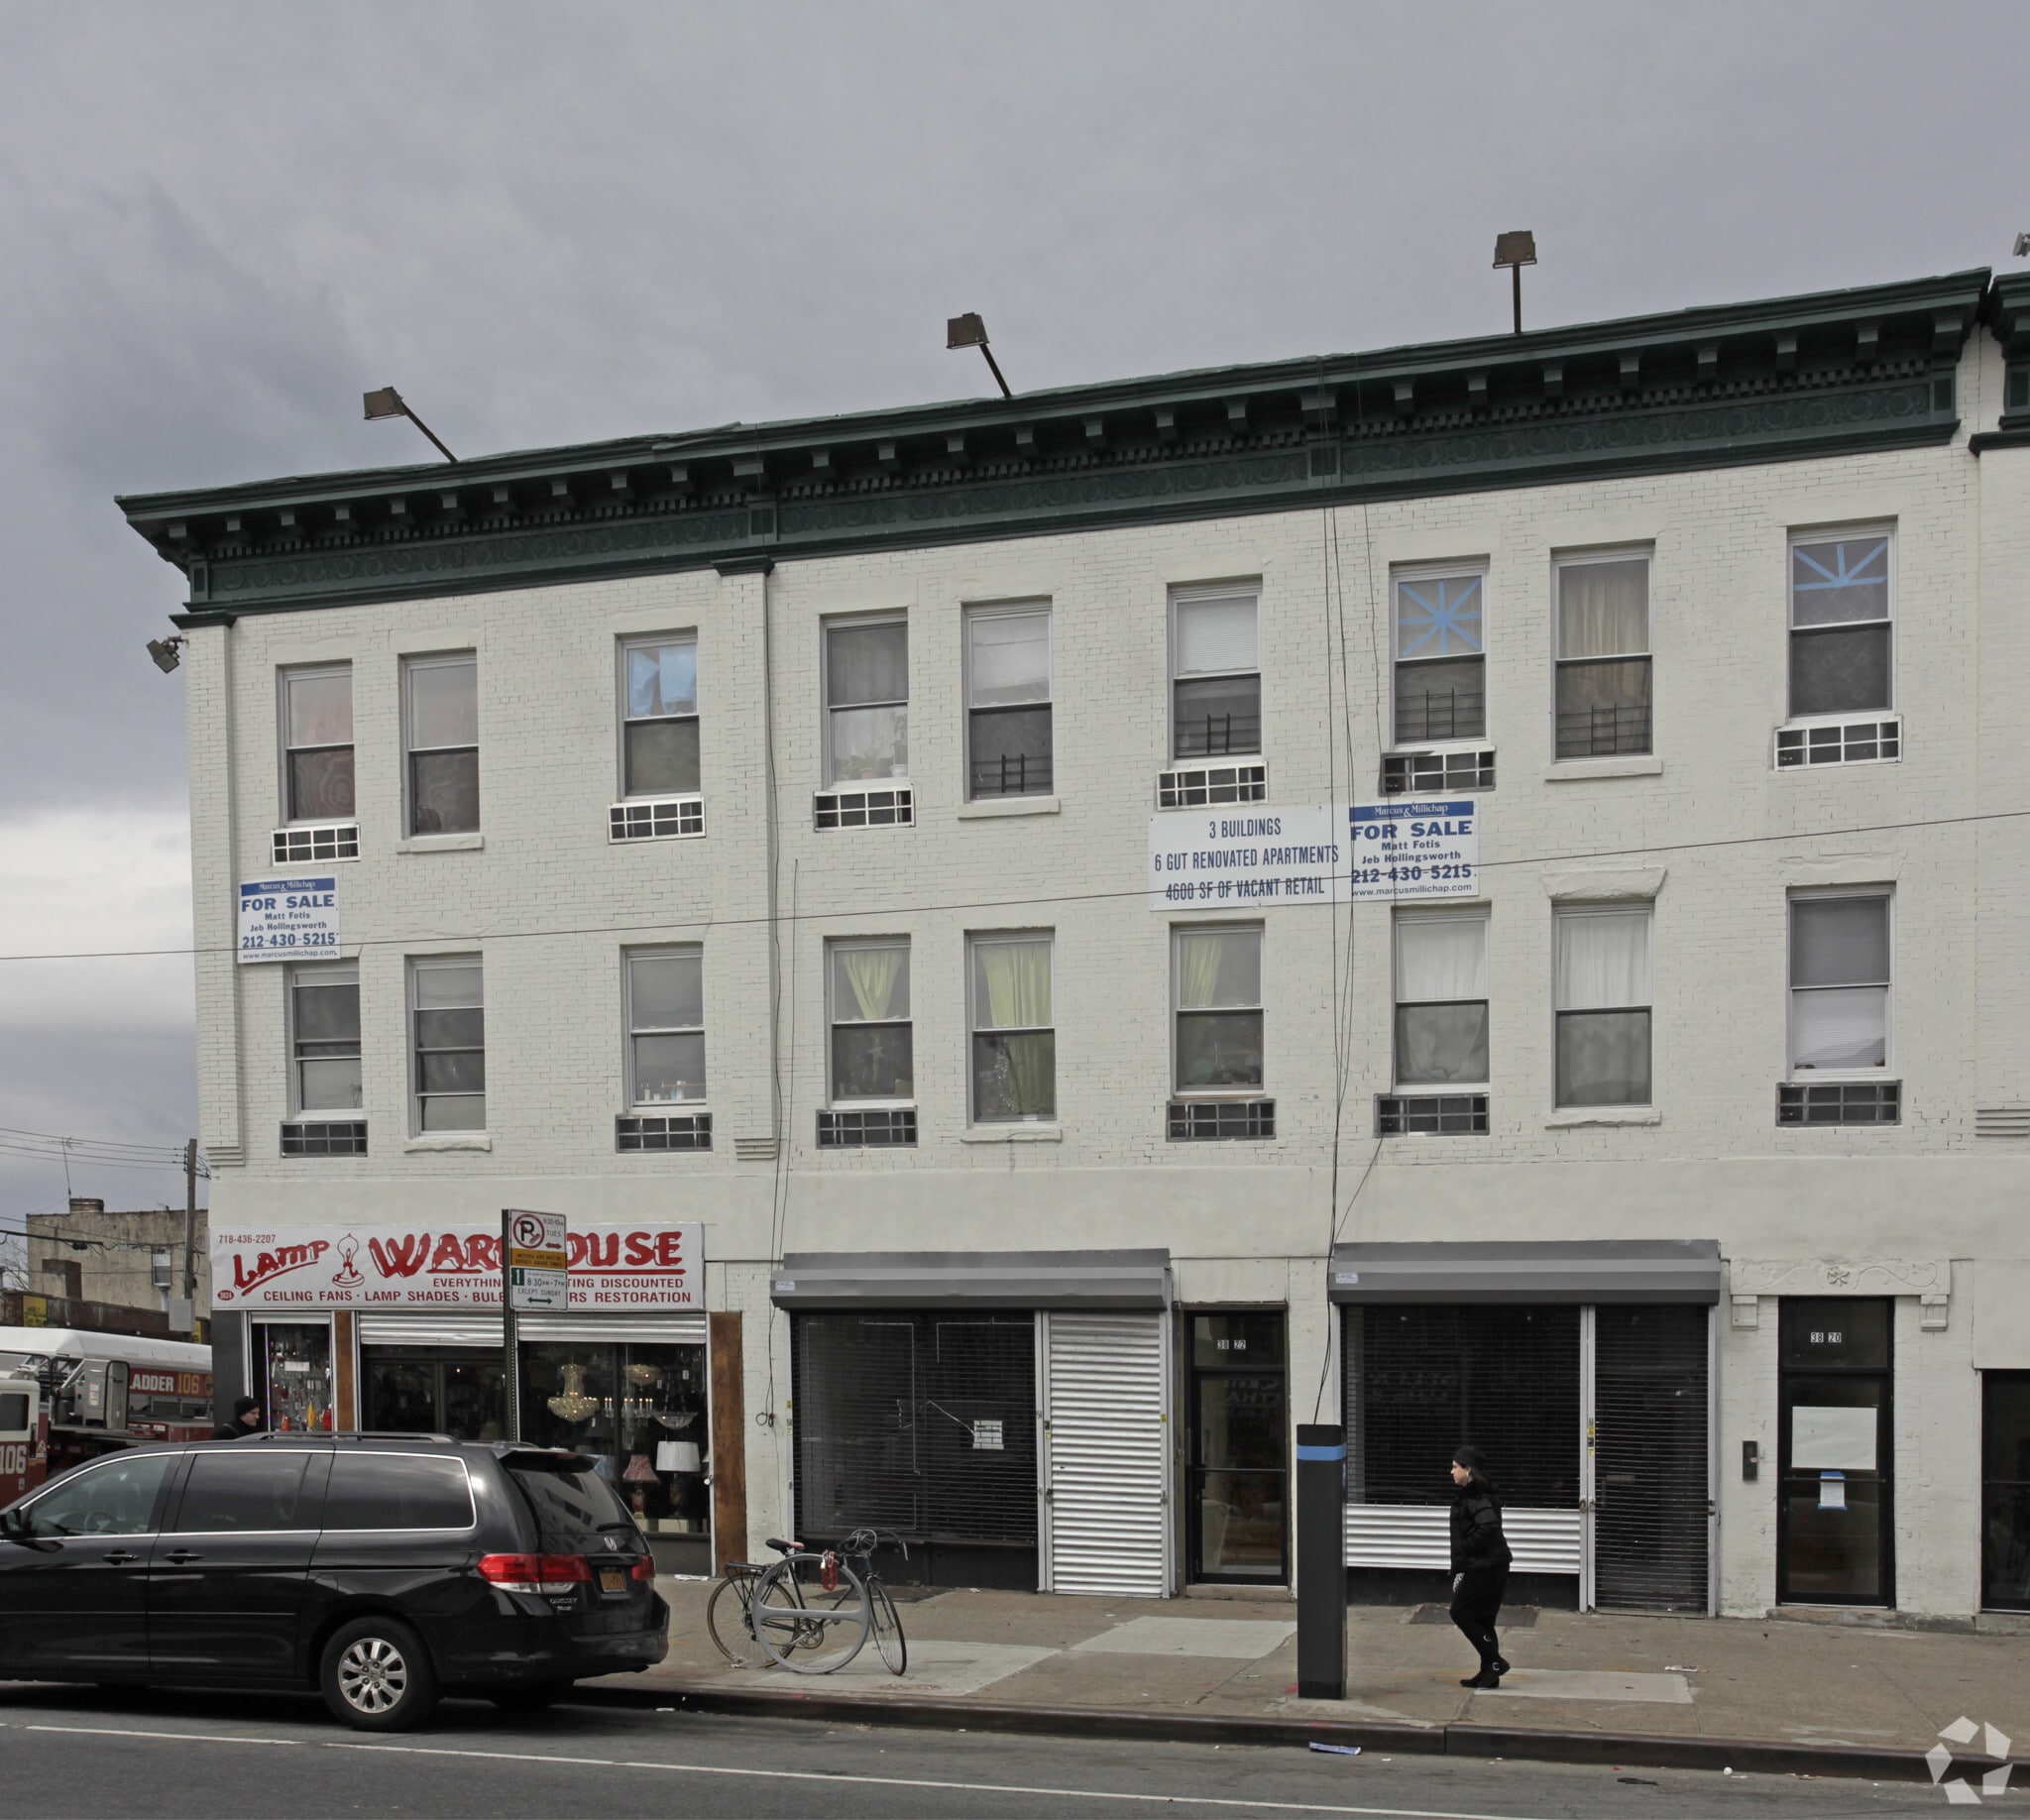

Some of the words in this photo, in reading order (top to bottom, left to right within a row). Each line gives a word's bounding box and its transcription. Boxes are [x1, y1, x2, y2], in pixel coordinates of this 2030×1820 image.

[1374, 807, 1403, 816] Marcus
[1403, 808, 1411, 818] &
[1411, 804, 1448, 815] Millichap
[1209, 821, 1216, 839] 3
[1221, 818, 1281, 838] BUILDINGS
[1350, 824, 1398, 841] FOR
[1410, 820, 1472, 837] SALE
[1381, 842, 1409, 851] Matt
[1412, 840, 1440, 850] Fotis
[1155, 853, 1162, 871] 6
[1167, 853, 1188, 870] GUT
[1192, 849, 1258, 869] RENOVATED
[1263, 845, 1339, 865] APARTMENTS
[1362, 855, 1380, 864] Jeb
[1384, 851, 1461, 864] Hollingsworth
[1351, 863, 1472, 884] 212-430-5215
[259, 882, 280, 891] Marcus
[280, 883, 287, 892] &
[286, 880, 316, 890] Millichap
[1166, 882, 1194, 901] 4600
[1199, 881, 1212, 899] SF
[1218, 880, 1232, 898] OF
[1237, 878, 1281, 897] VACANT
[1285, 876, 1325, 895] RETAIL
[1351, 884, 1472, 897] www.marcusmillichap.com
[241, 897, 277, 912] FOR
[286, 894, 335, 909] SALE
[267, 921, 327, 932] Hollingsworth
[242, 933, 336, 949] 212-430-5215
[243, 949, 337, 960] www.marcusmillichap.com
[218, 1234, 277, 1244] 718-436-2207
[368, 1231, 684, 1279] WAROUSE
[433, 1278, 503, 1288] EVERYTHIN
[601, 1278, 684, 1288] DISCOUNTED
[264, 1291, 313, 1302] CEILING
[319, 1291, 353, 1302] FANS
[365, 1291, 400, 1302] LAMP
[407, 1291, 460, 1302] SHADES
[473, 1292, 504, 1303] BUL
[595, 1292, 692, 1303] RESTORATION
[1812, 1332, 1824, 1343] 38
[1828, 1332, 1842, 1343] 20
[130, 1373, 174, 1392] ADDER
[177, 1373, 200, 1395] 106
[0, 1444, 28, 1475] 106
